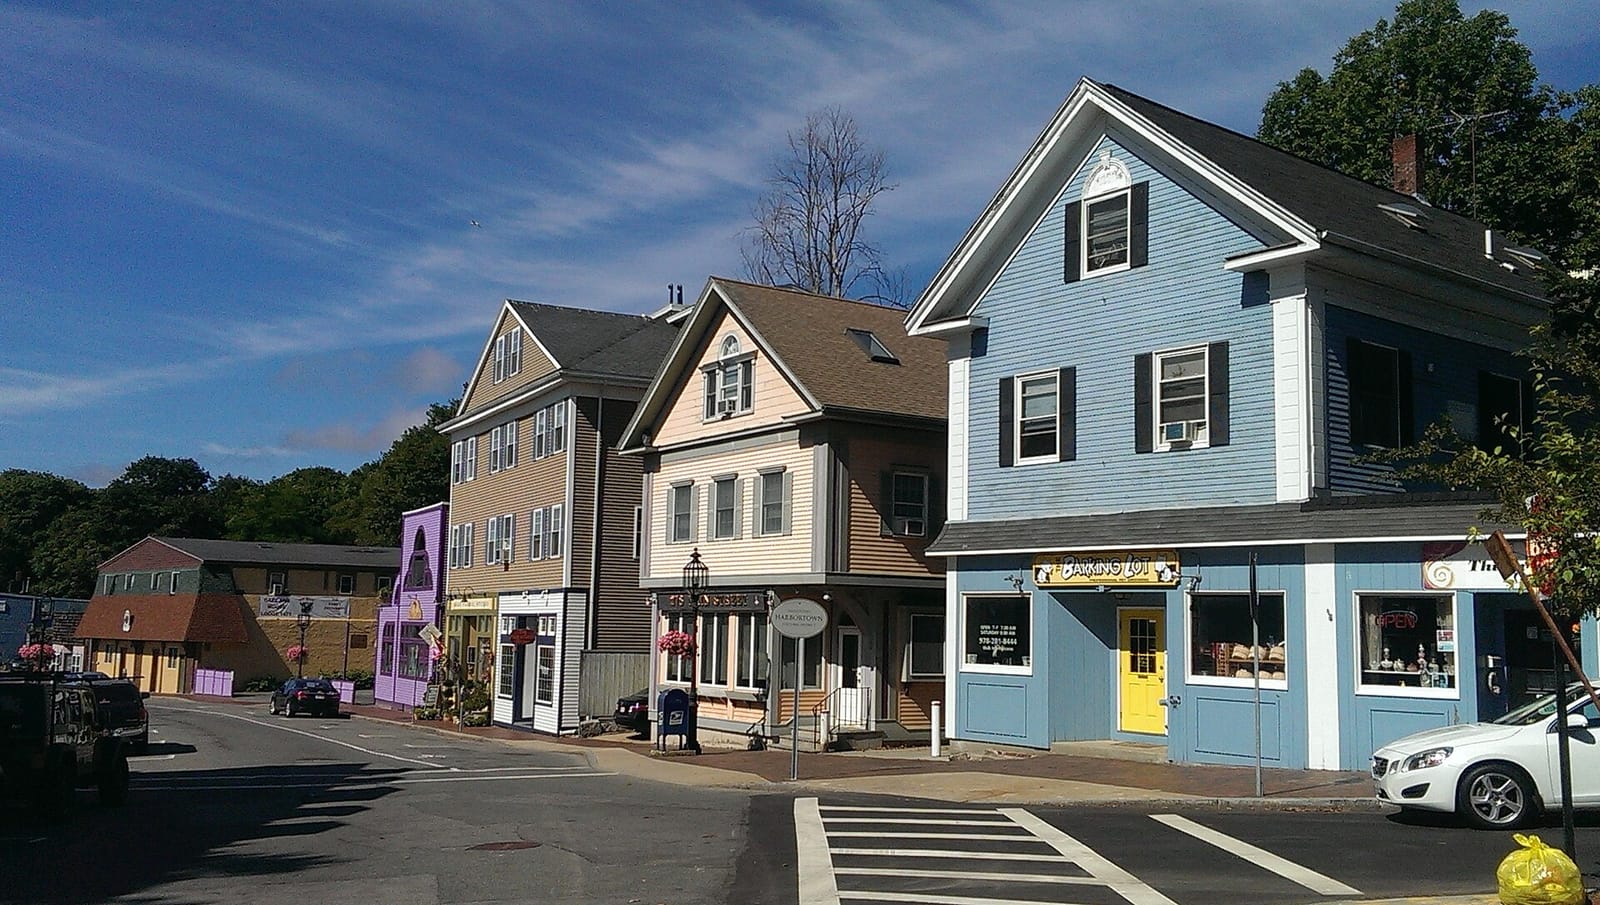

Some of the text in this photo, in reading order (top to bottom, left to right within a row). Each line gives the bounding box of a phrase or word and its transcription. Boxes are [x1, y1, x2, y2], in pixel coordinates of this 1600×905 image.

[1061, 555, 1121, 580] BARKING
[1123, 554, 1151, 578] LOT
[775, 613, 823, 622] HARBORTOWN
[1375, 614, 1416, 629] OPEN
